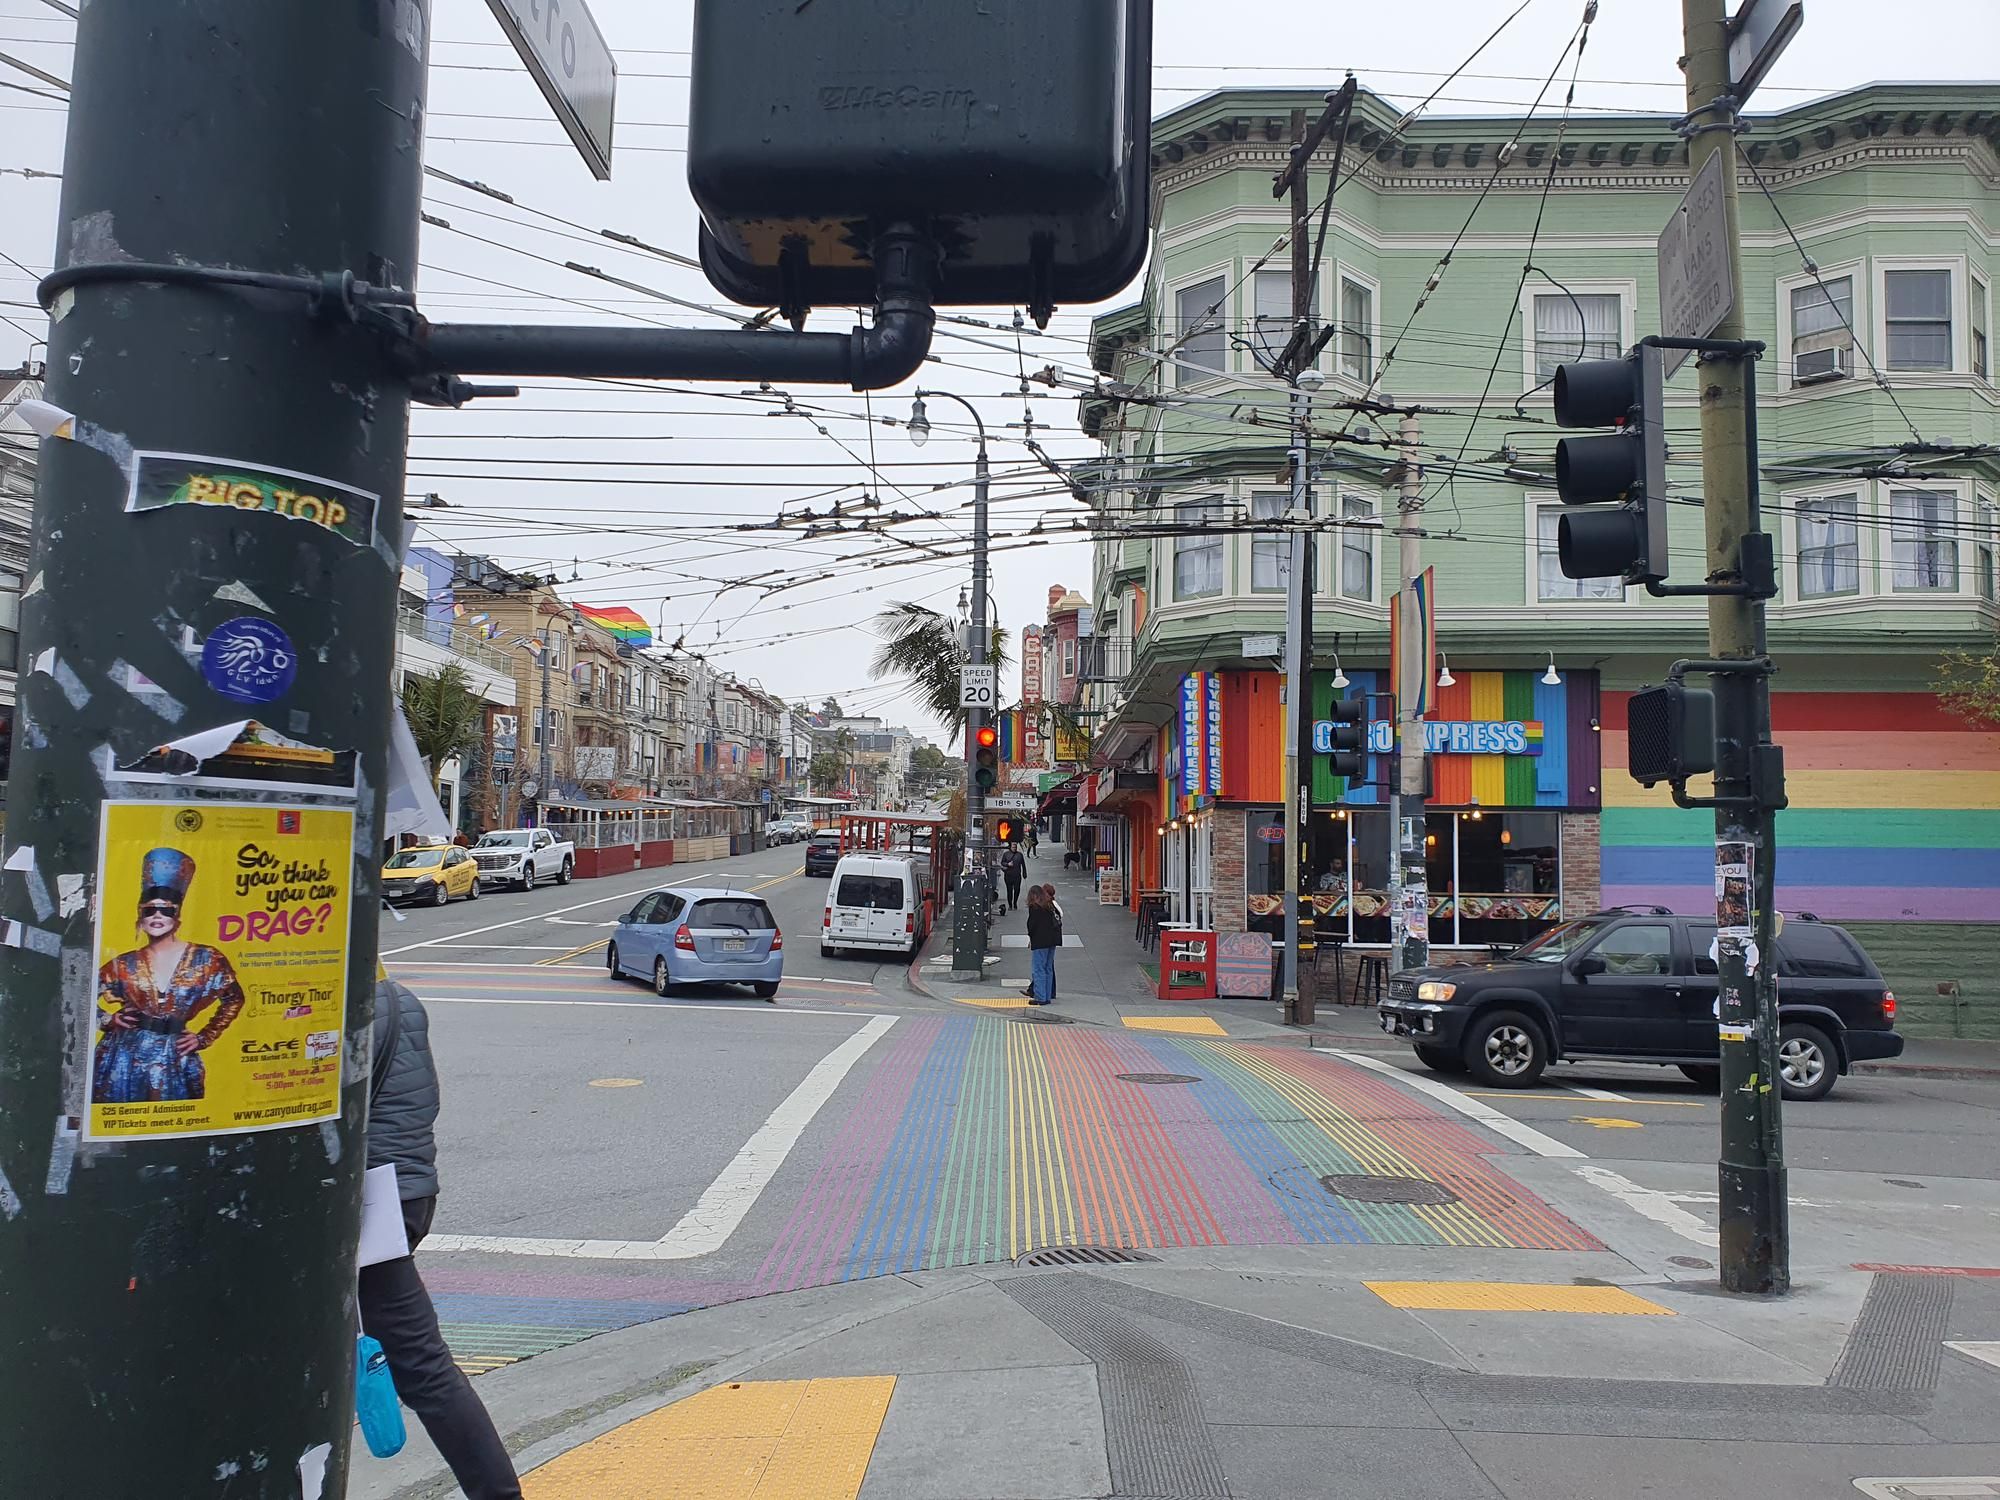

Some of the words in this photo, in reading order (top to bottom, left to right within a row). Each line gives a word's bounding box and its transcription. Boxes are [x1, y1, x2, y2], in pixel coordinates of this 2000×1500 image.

[273, 489, 347, 527] TOP
[964, 687, 990, 702] 20
[237, 843, 280, 868] So,
[236, 871, 279, 896] you
[282, 859, 330, 883] think
[1722, 867, 1742, 875] YOU
[266, 887, 305, 912] you
[309, 885, 337, 900] can
[217, 903, 332, 942] DRAG?
[260, 990, 305, 1006] Thorgy
[308, 988, 334, 1002] Thor
[241, 1038, 299, 1053] CAFÉ
[102, 1106, 116, 1116] $25
[118, 1105, 150, 1115] General
[153, 1103, 196, 1114] Admission
[233, 1100, 333, 1121] www.canyoudrag.com
[103, 1120, 116, 1129] VIP
[118, 1119, 147, 1128] Tickets
[150, 1118, 174, 1127] meet
[186, 1116, 210, 1126] greet
